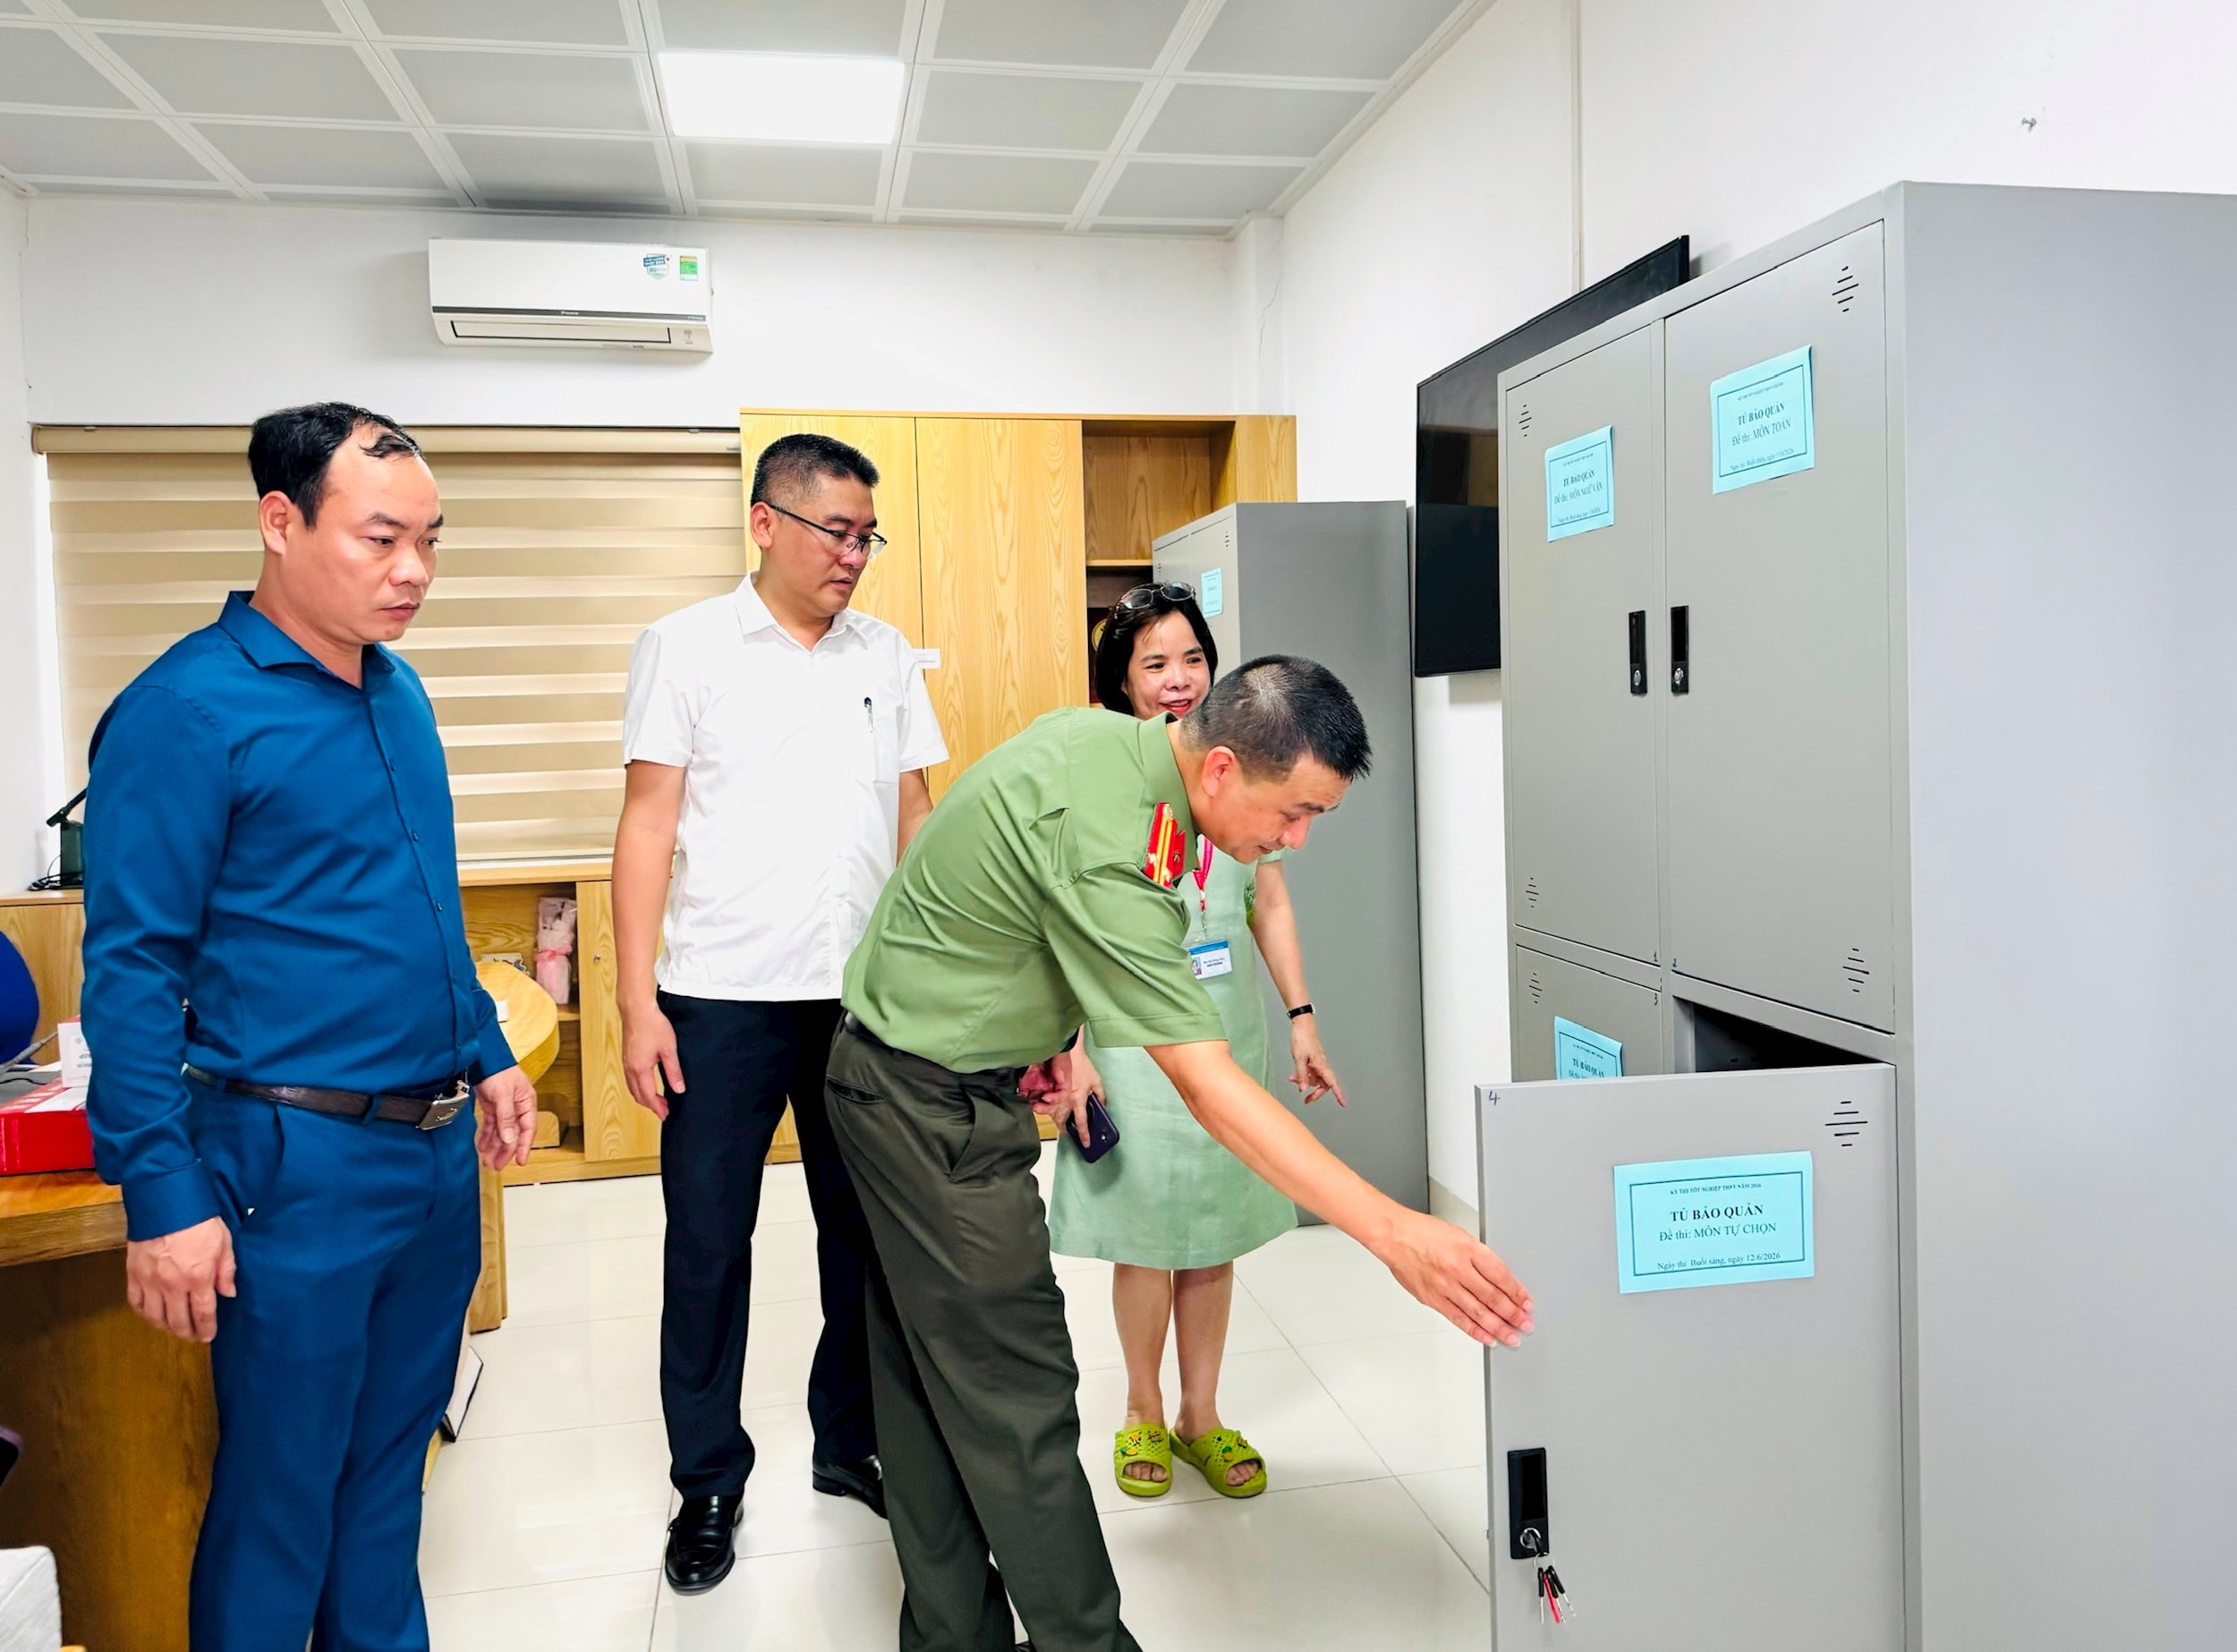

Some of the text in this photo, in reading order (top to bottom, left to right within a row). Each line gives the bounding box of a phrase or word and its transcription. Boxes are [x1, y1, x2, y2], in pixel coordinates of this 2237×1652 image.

[1748, 408, 1764, 422] BẢO
[1772, 418, 1790, 434] TOÁN
[1670, 1203, 1764, 1222] TỦ BẢO QUẢN
[1659, 1222, 1776, 1241] Đề thi: MÔN TỰ CHỌN
[1658, 1261, 1676, 1270] Ngày
[1690, 1256, 1707, 1266] Buổi
[1728, 1256, 1744, 1265] ngày
[1747, 1253, 1781, 1262] 12/6/2026
